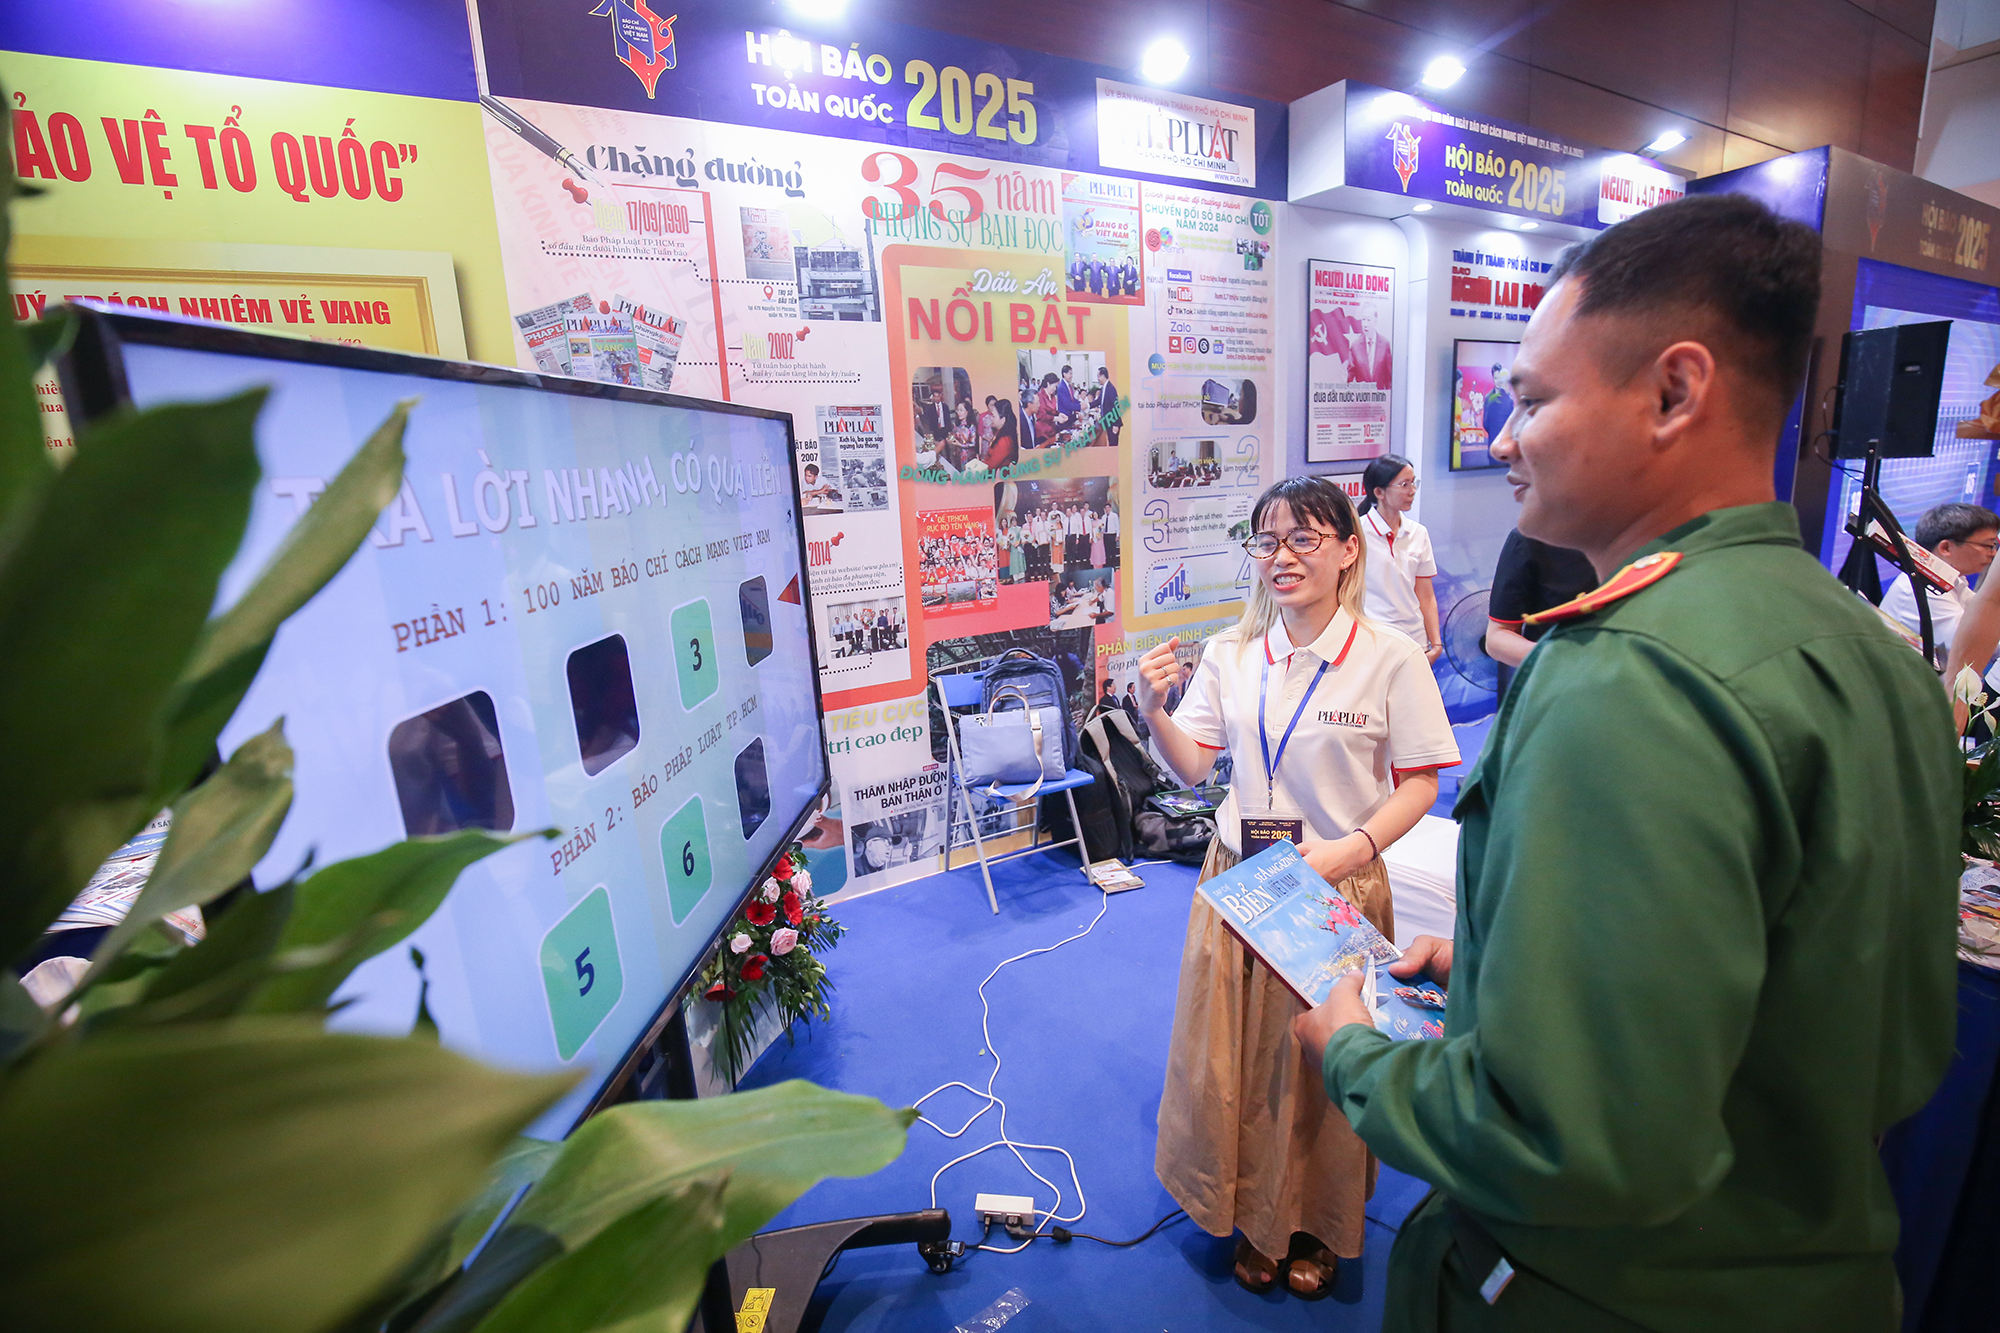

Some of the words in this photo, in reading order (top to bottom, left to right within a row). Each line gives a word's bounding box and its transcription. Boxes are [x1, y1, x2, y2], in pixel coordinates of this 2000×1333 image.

[751, 82, 820, 113] TOÀN
[824, 93, 894, 124] QUỐC
[821, 42, 892, 85] BÁO
[905, 59, 1037, 145] 2025
[1116, 89, 1130, 99] BAN
[1171, 99, 1194, 112] THÀNH
[1195, 103, 1208, 116] PHỐ
[1210, 105, 1220, 118] HỒ
[1221, 108, 1231, 120] CHÍ
[1232, 112, 1248, 122] MINH
[101, 109, 178, 199] VỆ
[184, 105, 258, 193] TỔ
[1193, 155, 1205, 167] CHÍ
[1207, 160, 1227, 171] MINH
[586, 143, 699, 189] Chặng
[704, 156, 805, 199] đường
[1445, 142, 1472, 176] HỘI
[1475, 150, 1506, 178] BÁO
[1508, 159, 1566, 216] 2025
[861, 151, 991, 224] 35
[994, 170, 1056, 215] năm
[1445, 179, 1473, 199] TOÀN
[1474, 183, 1503, 204] QUỐC
[593, 198, 626, 234] Ngày
[626, 199, 689, 237] 17/09/1990
[870, 200, 942, 242] PHỤNG
[947, 206, 974, 247] SỰ
[980, 212, 1018, 250] BẠN
[1024, 217, 1063, 253] ĐỌC
[1145, 201, 1181, 216] CHUYỂN
[1184, 205, 1200, 219] ĐỔI
[1201, 208, 1213, 221] SỐ
[1215, 210, 1233, 223] BÁO
[1235, 214, 1249, 226] CHÍ
[1176, 217, 1197, 230] NĂM
[1199, 221, 1219, 232] 2024
[1252, 208, 1270, 228] TỐT
[558, 241, 574, 250] đầu
[575, 242, 591, 251] tiên
[592, 244, 611, 252] dưới
[612, 245, 631, 253] hình
[632, 246, 650, 255] thức
[652, 246, 672, 255] Tuần
[673, 248, 688, 256] báo
[582, 235, 598, 243] Báo
[600, 235, 621, 246] Pháp
[623, 237, 640, 247] Luật
[642, 238, 675, 248] TP.HCM
[1112, 230, 1129, 239] NAM
[1955, 214, 1991, 271] 2025
[973, 268, 1018, 293] Dấu
[1022, 268, 1058, 296] Ấn
[1314, 268, 1344, 289] NGƯỜI
[1346, 274, 1364, 290] LAO
[1366, 273, 1389, 292] ĐỘNG
[278, 293, 315, 323] VẺ
[320, 300, 391, 324] VANG
[908, 281, 993, 341] NỔI
[1010, 293, 1091, 355] BẬT
[1170, 321, 1192, 333] Zalo
[743, 332, 767, 359] Năm
[768, 333, 794, 359] 2002
[1314, 390, 1326, 402] đưa
[1327, 388, 1338, 402] đất
[1339, 389, 1355, 402] nước
[1356, 390, 1371, 402] vươn
[900, 461, 949, 485] ĐỒNG
[999, 457, 1041, 480] CÙNG
[1044, 449, 1062, 467] SỰ
[1064, 426, 1098, 458] PHÁT
[1097, 395, 1131, 432] TRIỂN
[801, 453, 818, 462] 2007
[1236, 435, 1260, 487] 2
[441, 447, 537, 538] LỜI
[543, 454, 667, 524] NHANH,
[670, 439, 702, 494] CÓ
[750, 452, 782, 498] LIỀN
[1144, 499, 1170, 552] 3
[808, 541, 831, 567] 2014
[391, 602, 467, 652] PHẦN
[484, 598, 508, 627] 1:
[522, 581, 560, 615] 100
[570, 568, 604, 601] NĂM
[611, 558, 639, 588] BÁO
[645, 549, 670, 579] CHÍ
[674, 542, 702, 570] CÁCH
[706, 537, 730, 563] MẠNG
[732, 531, 753, 554] VIỆT
[756, 528, 771, 545] NAM
[688, 638, 703, 672] 3
[1097, 637, 1132, 657] PHẢN
[1136, 634, 1162, 650] BIỆN
[830, 707, 877, 733] TIÊU
[883, 699, 926, 723] CỰC
[828, 739, 850, 755] trị
[855, 732, 886, 748] cao
[890, 725, 923, 742] đẹp
[551, 822, 597, 876] PHẦN
[605, 806, 623, 832] 2:
[631, 774, 658, 809] BÁO
[664, 745, 692, 782] PHÁP
[697, 721, 722, 755] LUẬT
[726, 694, 758, 731] TP.HCM
[854, 783, 885, 801] THÂM
[888, 776, 916, 793] NHẬP
[881, 791, 902, 809] BÁN
[905, 786, 933, 802] THẬN
[1271, 830, 1292, 840] 2025
[682, 840, 695, 877] 6
[1254, 865, 1270, 882] SEA
[1266, 852, 1298, 877] MAGAZINE
[1221, 882, 1277, 925] BIỂN
[574, 946, 595, 998] 5
